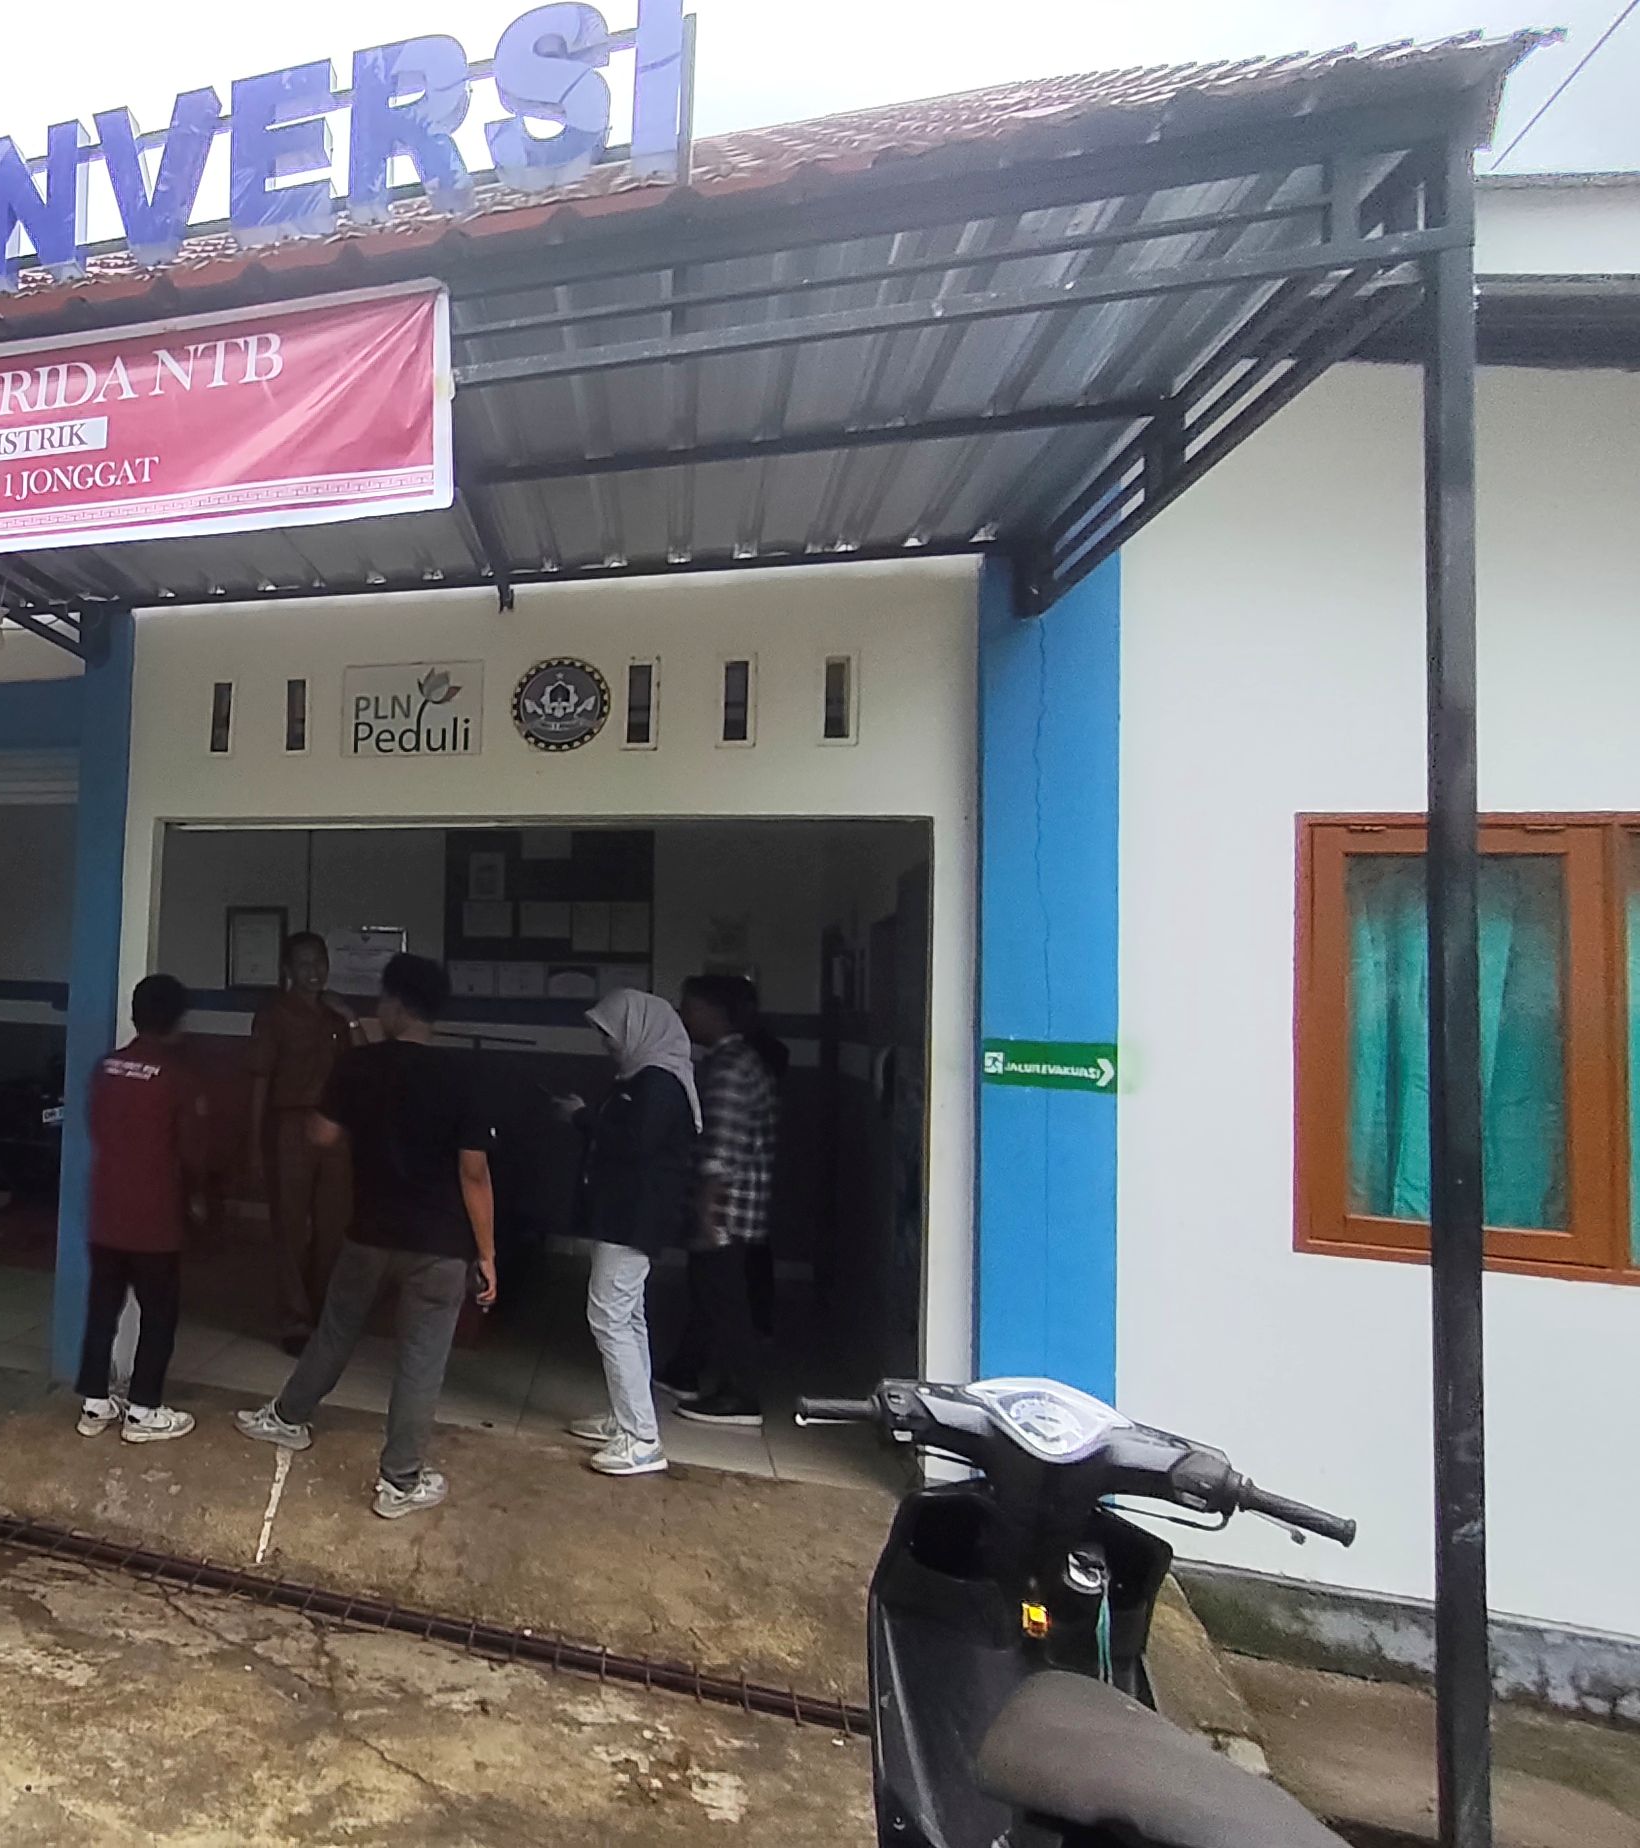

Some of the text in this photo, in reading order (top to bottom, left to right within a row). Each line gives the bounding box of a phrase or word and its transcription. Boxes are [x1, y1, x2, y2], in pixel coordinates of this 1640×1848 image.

[150, 332, 285, 396] NTB
[14, 455, 161, 501] JONGGAT
[354, 694, 411, 721] PLN
[353, 716, 471, 753] Peduli
[1005, 1063, 1101, 1079] JALUR EVAKUASI
